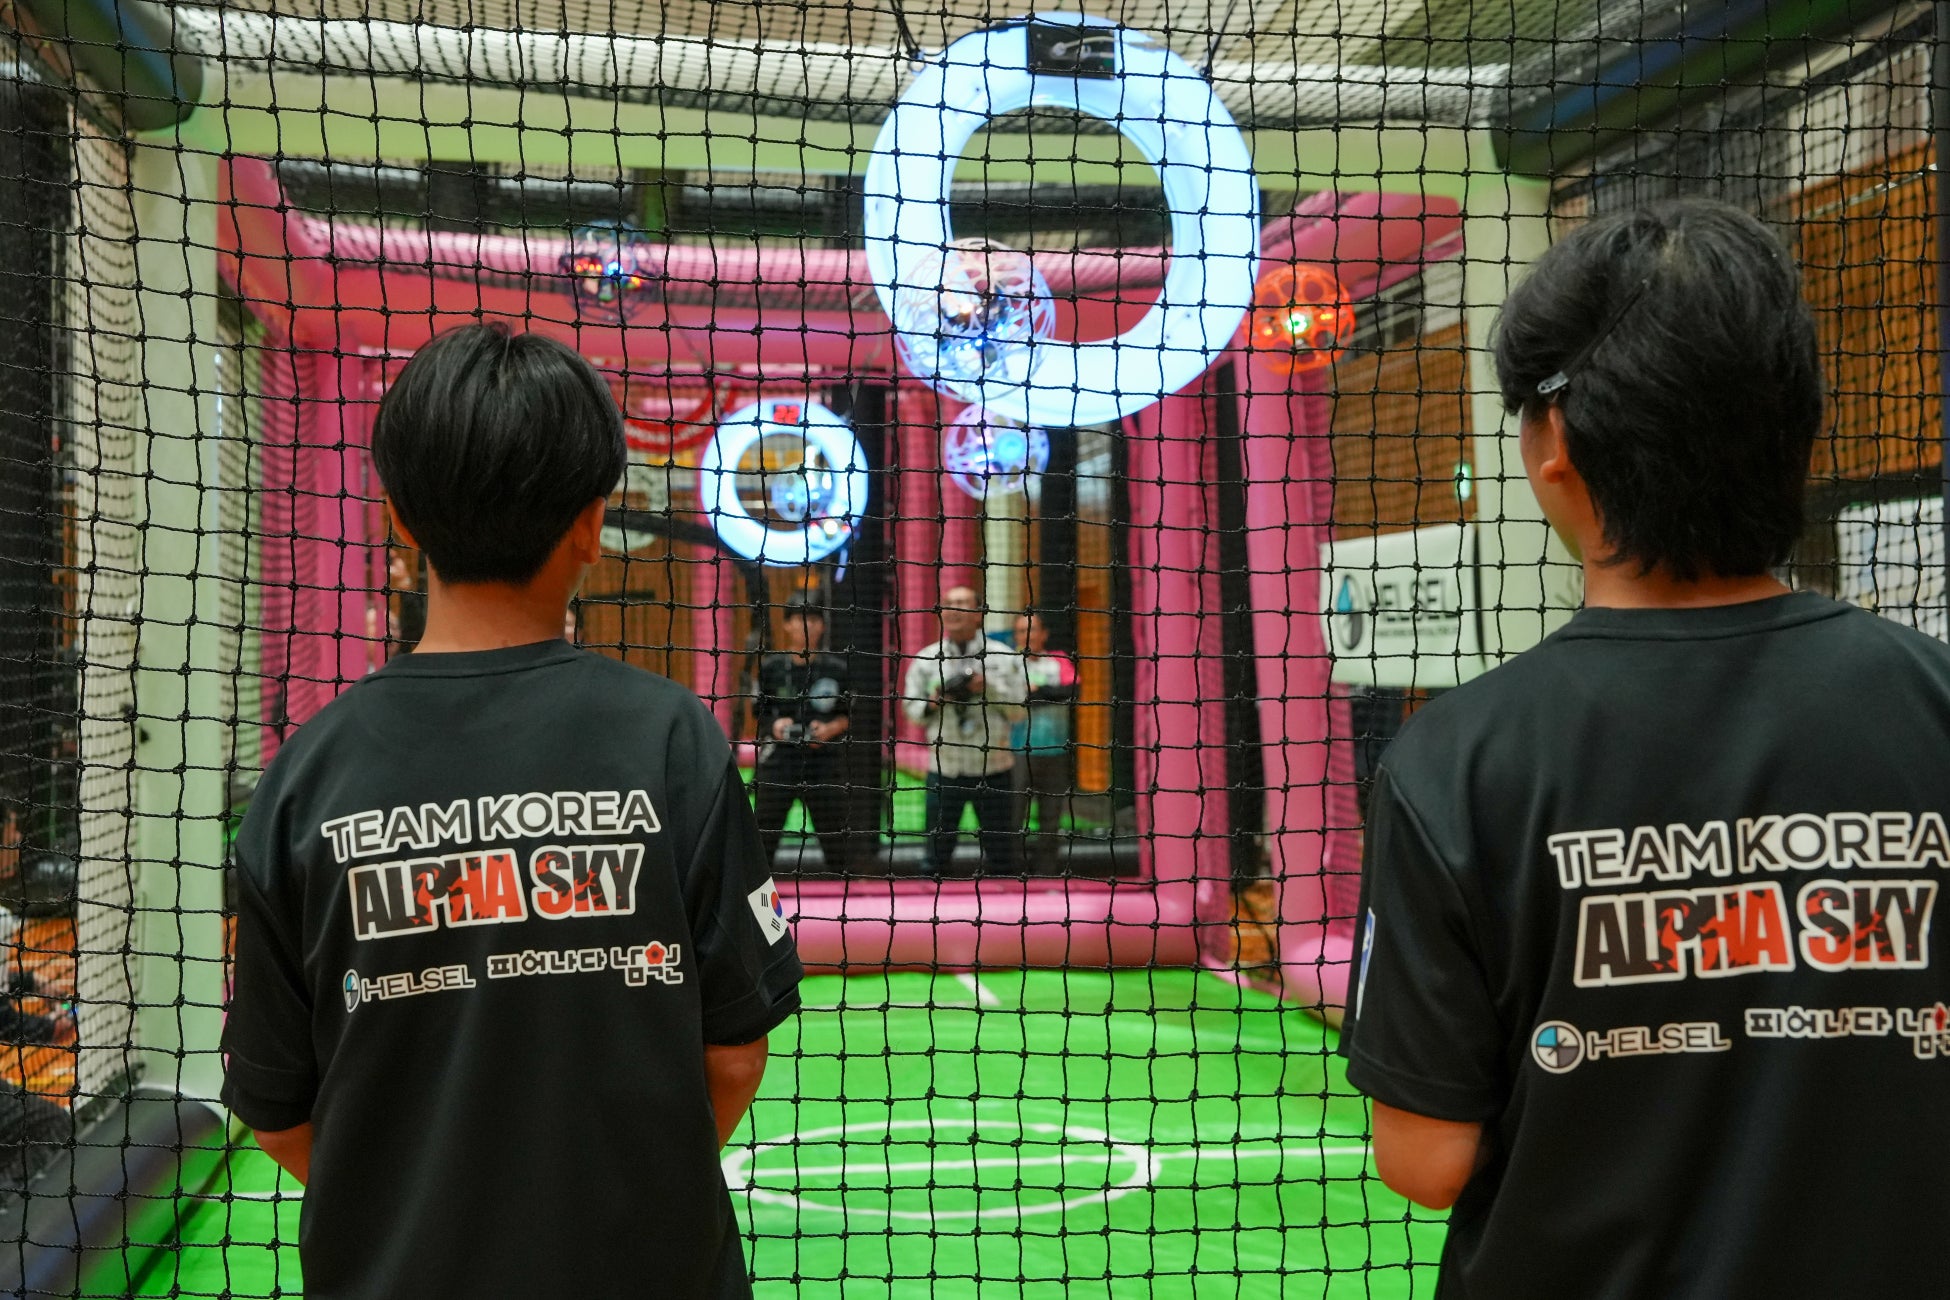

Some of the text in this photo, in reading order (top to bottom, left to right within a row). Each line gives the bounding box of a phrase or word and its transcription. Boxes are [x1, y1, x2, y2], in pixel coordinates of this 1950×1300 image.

[322, 791, 660, 863] TEAM KOREA
[1548, 813, 1950, 888] TEAM KOREA
[349, 844, 644, 940] ALPHA SKY
[1575, 879, 1937, 986] ALPHA SKY
[362, 966, 475, 1001] HELSEL
[488, 949, 606, 978] 피어나다
[1587, 1023, 1730, 1059] HELSEL
[1746, 1007, 1892, 1037] 피어나다
